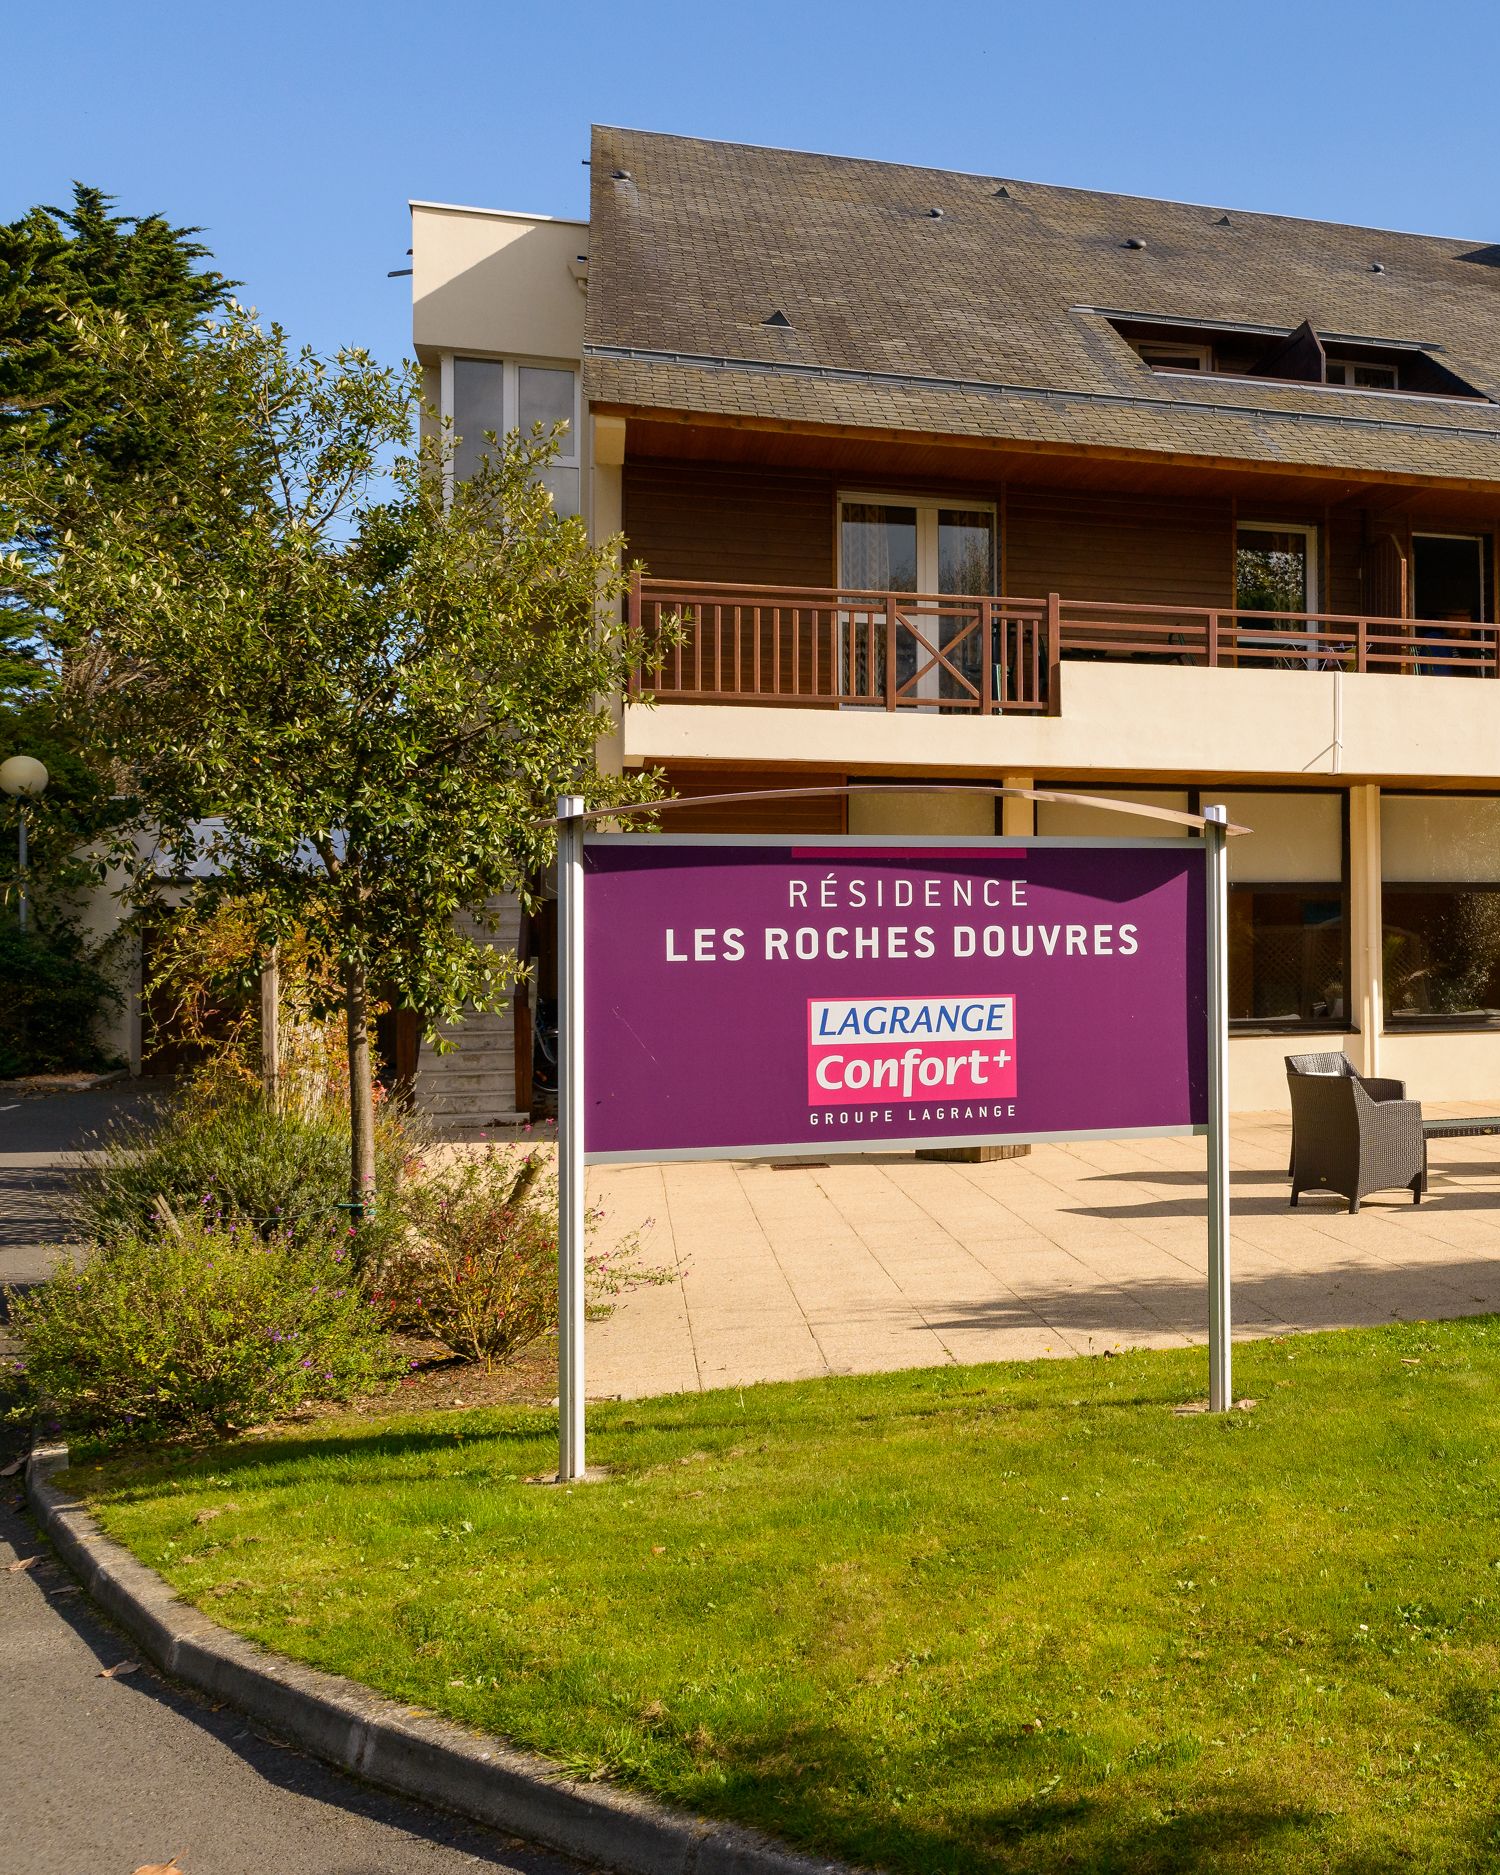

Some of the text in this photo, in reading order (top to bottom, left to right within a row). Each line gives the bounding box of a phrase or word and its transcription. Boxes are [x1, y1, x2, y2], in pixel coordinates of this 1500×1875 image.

[789, 872, 1028, 908] RÉSIDENCE
[665, 923, 1139, 962] LES ROCHES DOUVRES
[818, 1003, 1006, 1036] LAGRANGE
[809, 1104, 1016, 1126] GROUPE LAGRANGE
